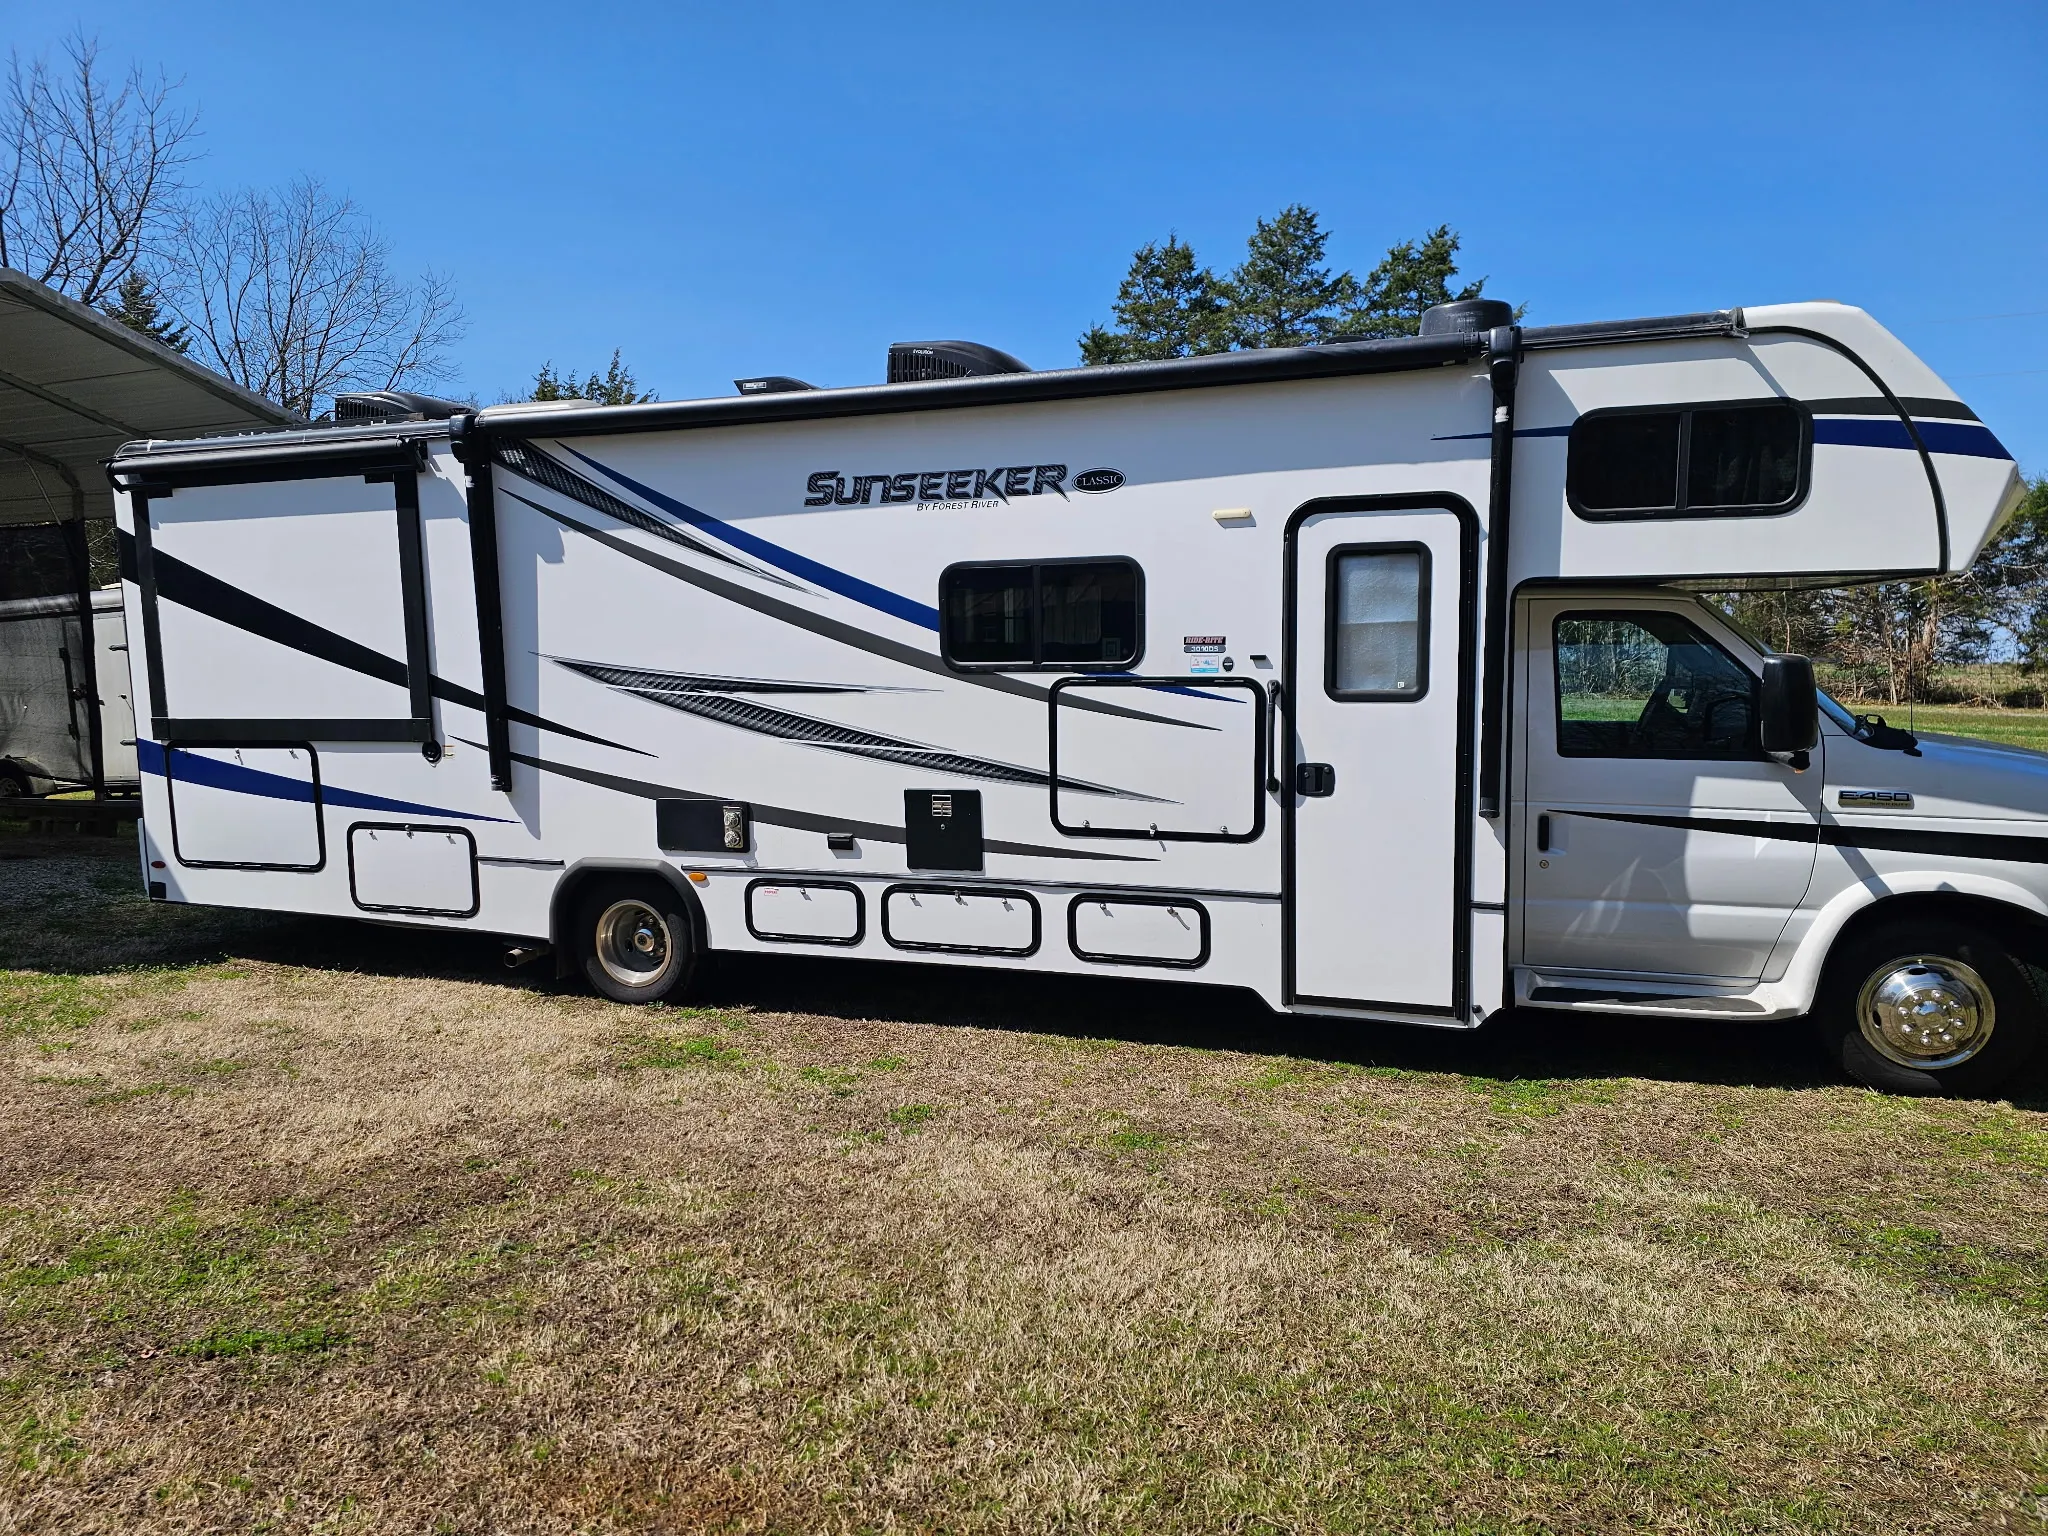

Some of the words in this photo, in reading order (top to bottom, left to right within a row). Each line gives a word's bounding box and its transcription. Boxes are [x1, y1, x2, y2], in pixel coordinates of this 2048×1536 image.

[1074, 474, 1122, 487] CLASSIC
[916, 503, 931, 512] BY
[932, 501, 970, 511] FOREST
[970, 500, 999, 509] RIVER
[1839, 790, 1910, 801] E-450
